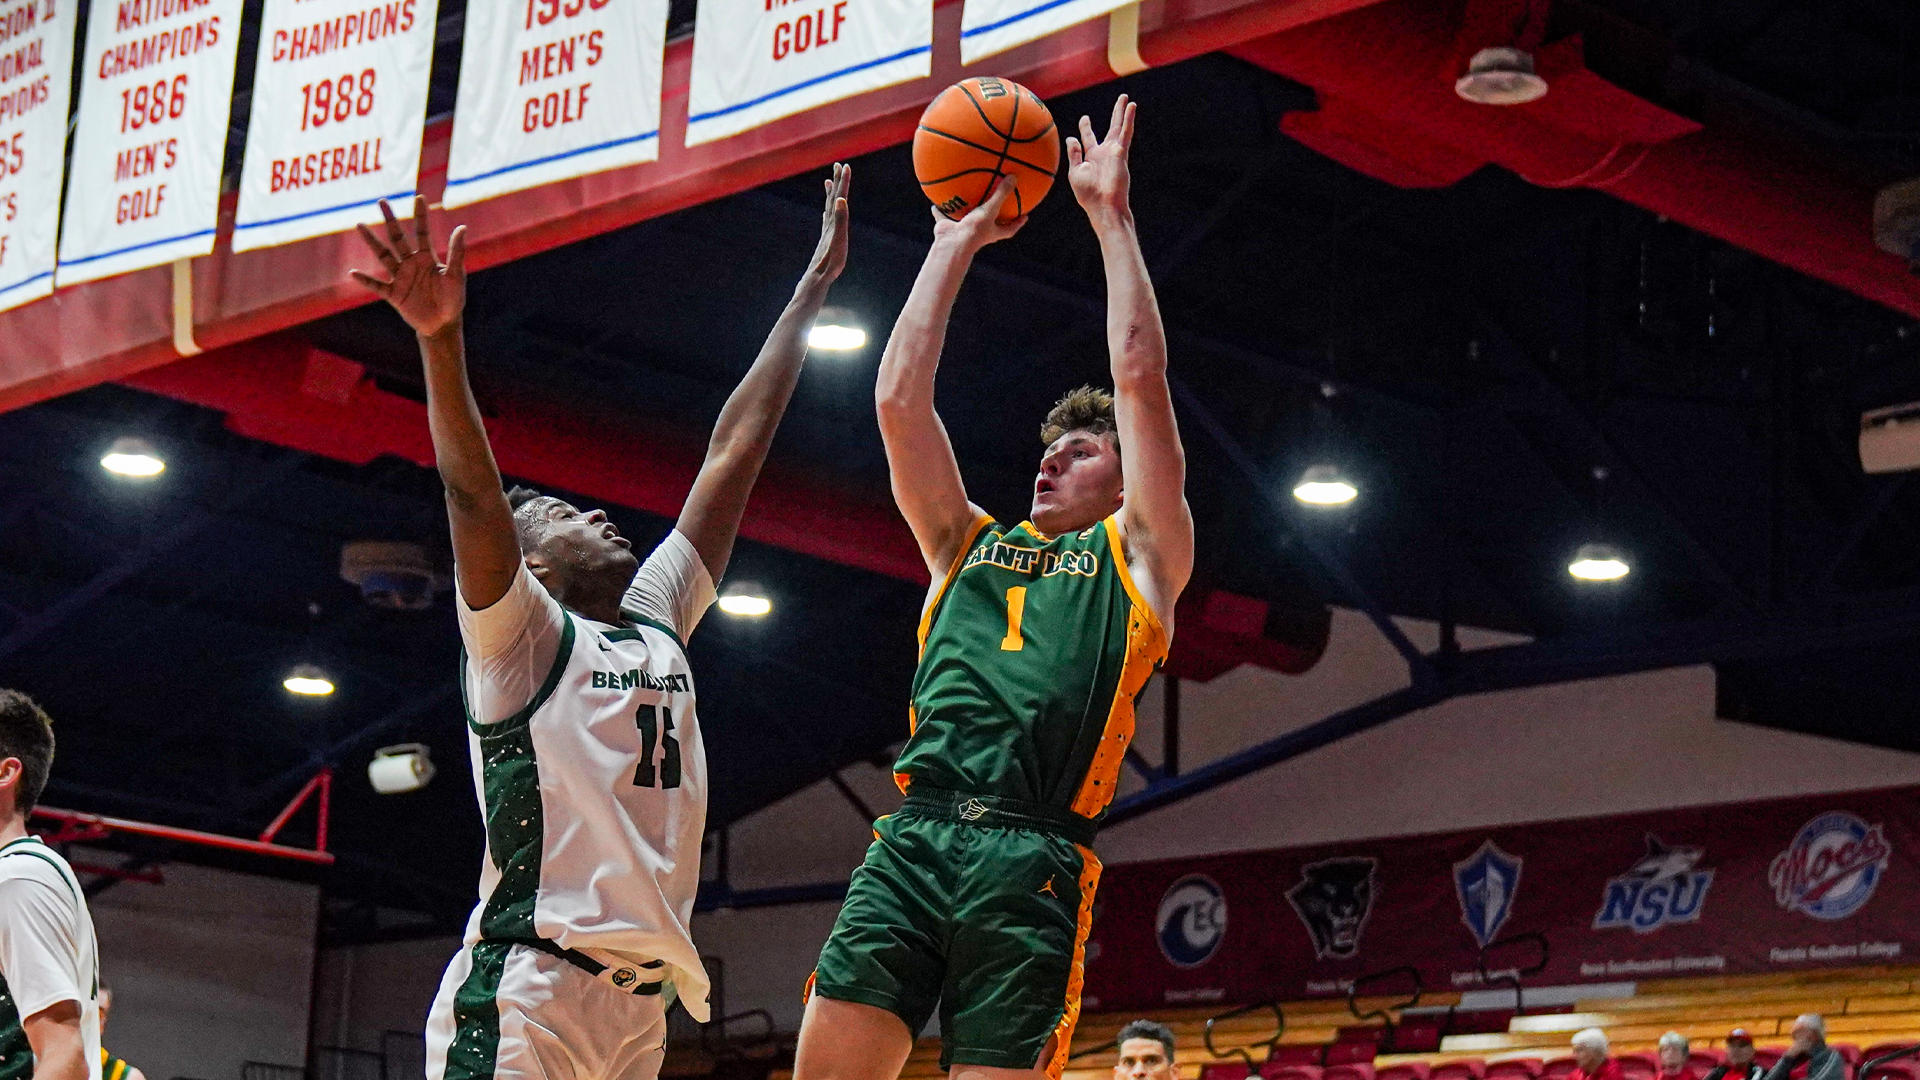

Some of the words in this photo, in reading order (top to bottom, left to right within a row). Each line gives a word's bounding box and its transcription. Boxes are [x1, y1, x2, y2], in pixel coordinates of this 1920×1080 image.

[98, 15, 221, 80] CHAMPIONS
[272, 0, 417, 63] CHAMPIONS
[518, 29, 605, 86] MEN'S
[772, 0, 848, 62] GOLF
[120, 73, 189, 134] 1986
[300, 67, 377, 132] 1988
[522, 82, 592, 134] GOLF
[115, 137, 178, 182] MEN'S
[270, 137, 383, 194] BASEBALL
[116, 184, 167, 225] GOLF
[960, 542, 1041, 574] AINT
[1042, 550, 1098, 577] LEO
[1000, 585, 1028, 652] 1
[632, 703, 682, 790] 15
[1597, 868, 1711, 930] NSU
